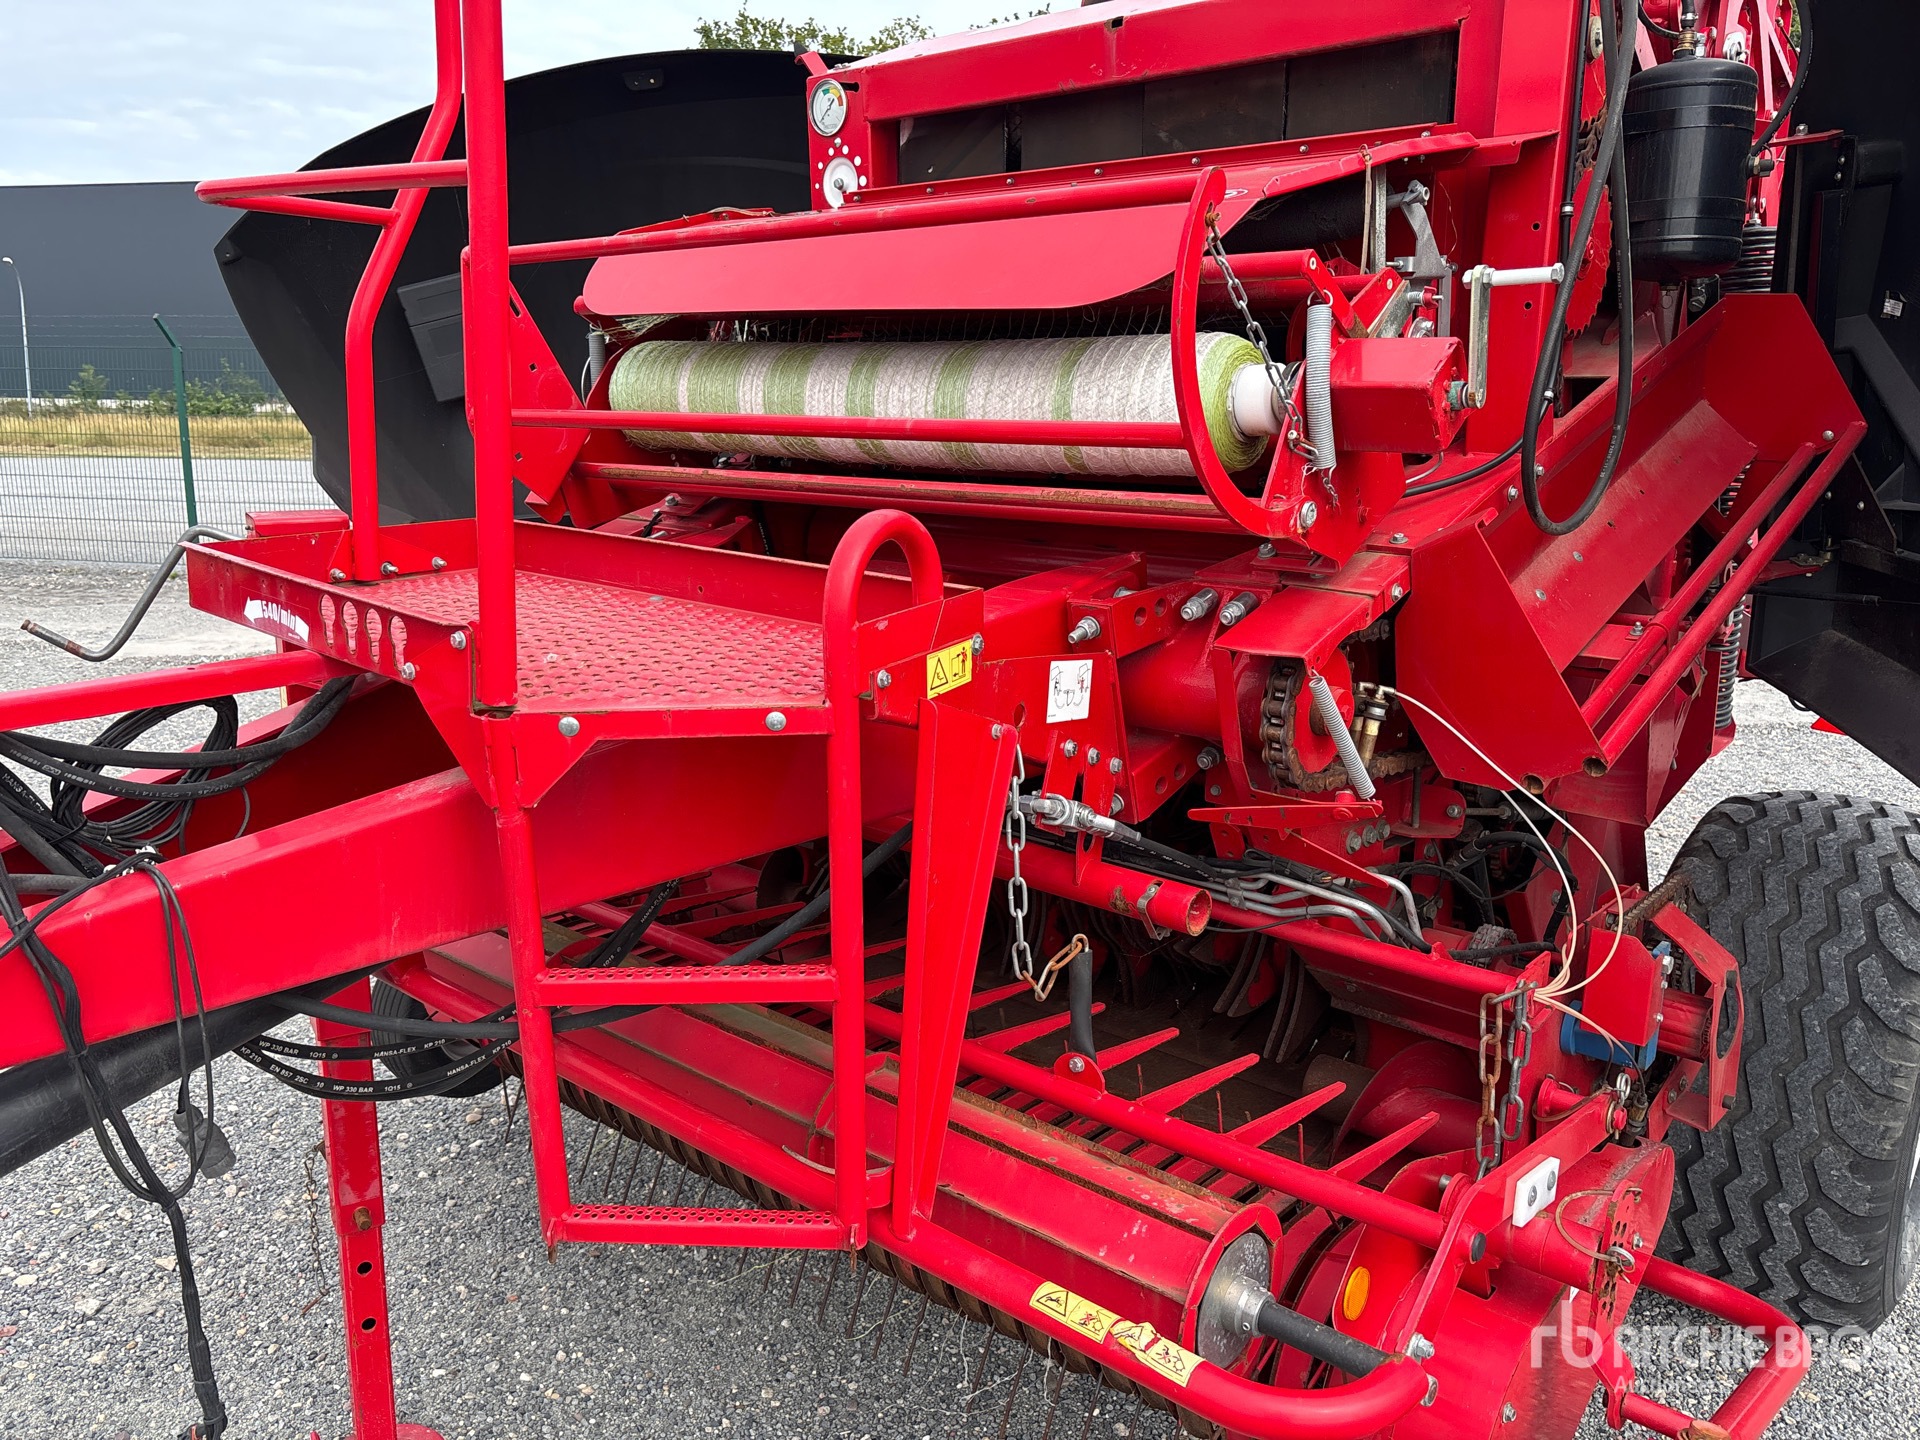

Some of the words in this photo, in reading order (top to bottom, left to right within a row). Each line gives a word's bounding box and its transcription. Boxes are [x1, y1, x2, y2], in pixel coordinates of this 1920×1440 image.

[261, 600, 295, 632] 540/min
[240, 1046, 250, 1055] KP
[249, 1052, 262, 1063] 210
[269, 1064, 280, 1073] EN
[280, 1067, 293, 1078] 857
[294, 1075, 309, 1084] 2SC
[447, 1054, 487, 1077] HANSA-FLEX
[492, 1046, 501, 1054] KP
[501, 1039, 512, 1050] 210
[259, 1040, 271, 1049] WP
[271, 1043, 283, 1052] 330
[283, 1047, 300, 1055] BAR
[374, 1046, 417, 1057] HANSA-FLEX
[434, 1038, 446, 1047] 210
